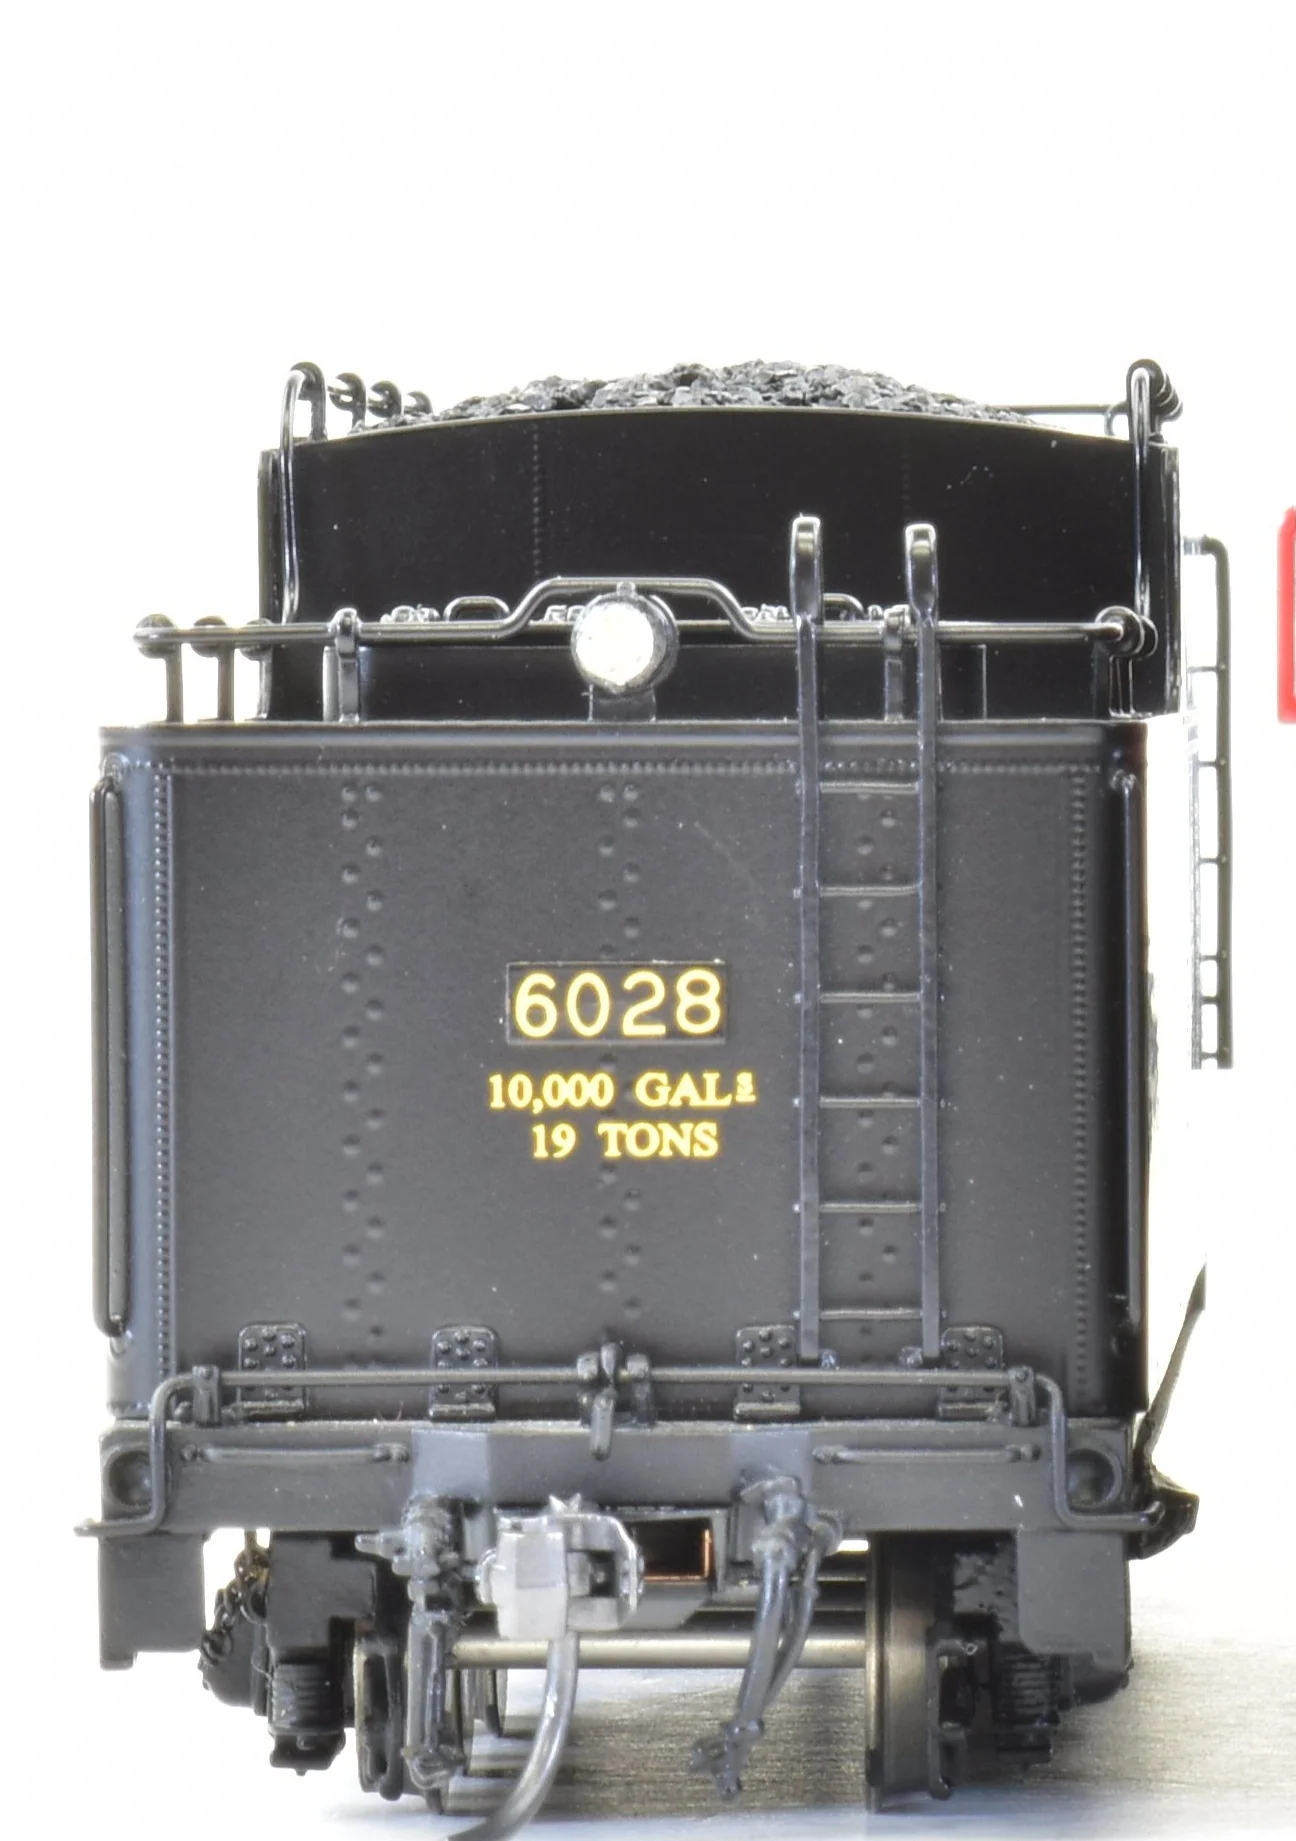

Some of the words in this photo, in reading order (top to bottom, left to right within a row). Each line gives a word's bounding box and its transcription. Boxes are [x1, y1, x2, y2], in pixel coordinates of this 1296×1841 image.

[514, 968, 721, 1038] 6028
[488, 1072, 615, 1114] 10,000
[531, 1122, 577, 1159] 19
[597, 1121, 719, 1159] TONS
